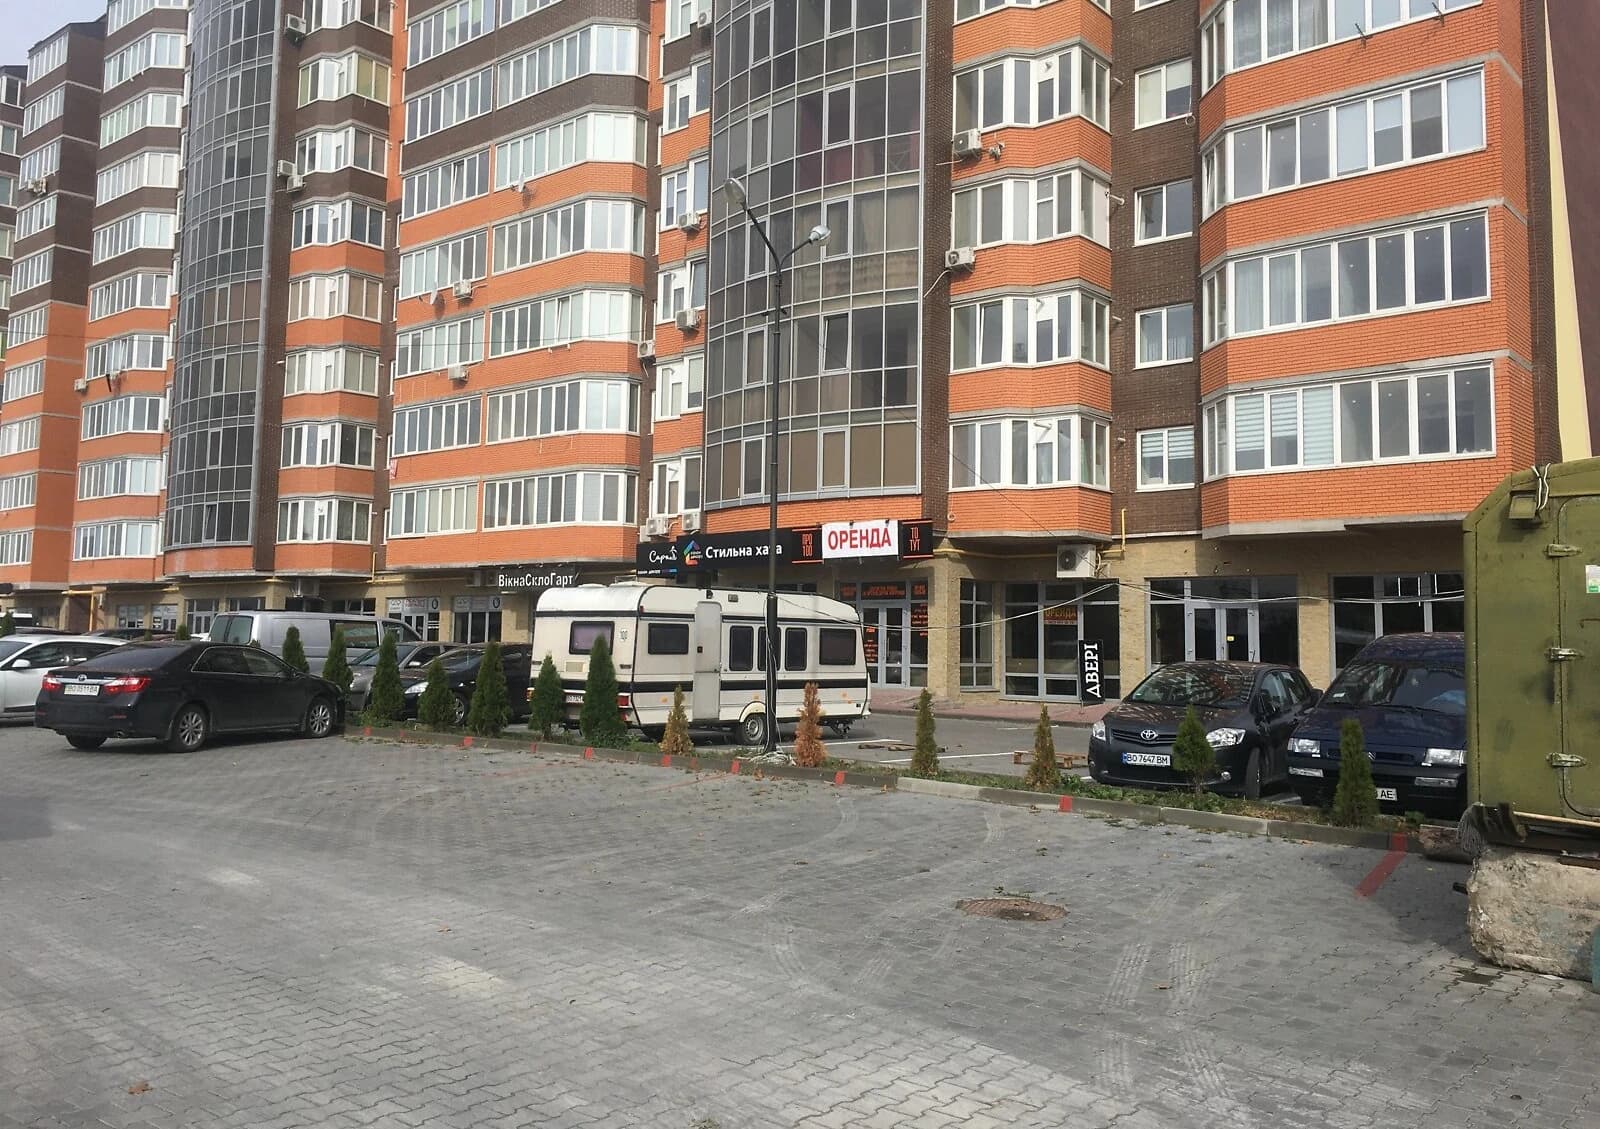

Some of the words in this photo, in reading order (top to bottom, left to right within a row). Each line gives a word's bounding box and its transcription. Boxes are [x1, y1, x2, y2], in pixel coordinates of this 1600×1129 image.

[802, 533, 813, 545] ПРО
[828, 528, 892, 550] ОРЕНДА
[911, 527, 919, 539] ТО
[705, 545, 752, 558] Стильна
[756, 544, 783, 556] хаа
[909, 539, 920, 551] ТУТ
[498, 572, 574, 588] ВікнаСклоГарт
[1083, 643, 1102, 698] ДВЕРІ
[1138, 754, 1155, 763] 7647
[1157, 756, 1168, 764] BM
[1381, 790, 1393, 798] AE
